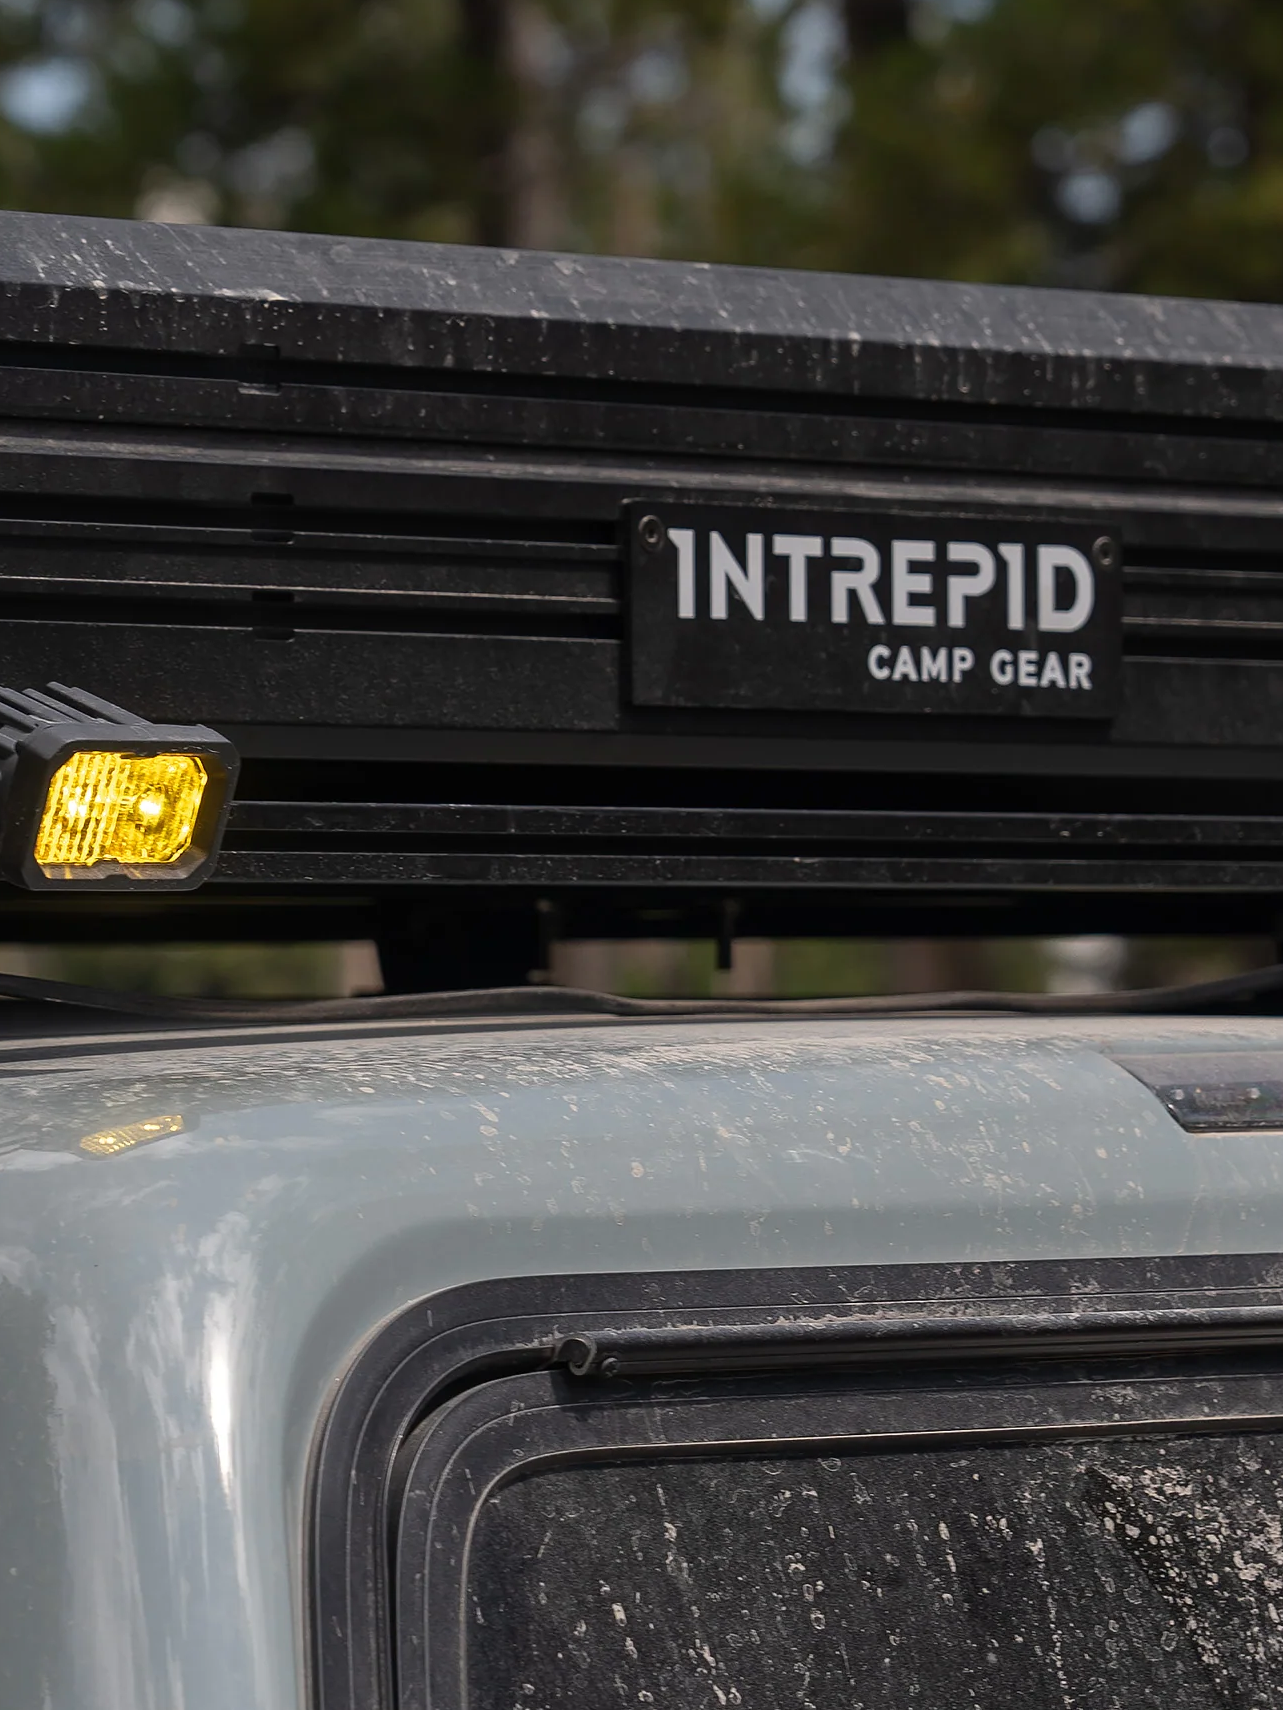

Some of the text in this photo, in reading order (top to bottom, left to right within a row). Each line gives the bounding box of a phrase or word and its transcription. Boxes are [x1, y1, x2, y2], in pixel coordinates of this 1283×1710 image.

[666, 527, 1096, 634] INTREPID
[867, 644, 1093, 691] CAMP GEAR
